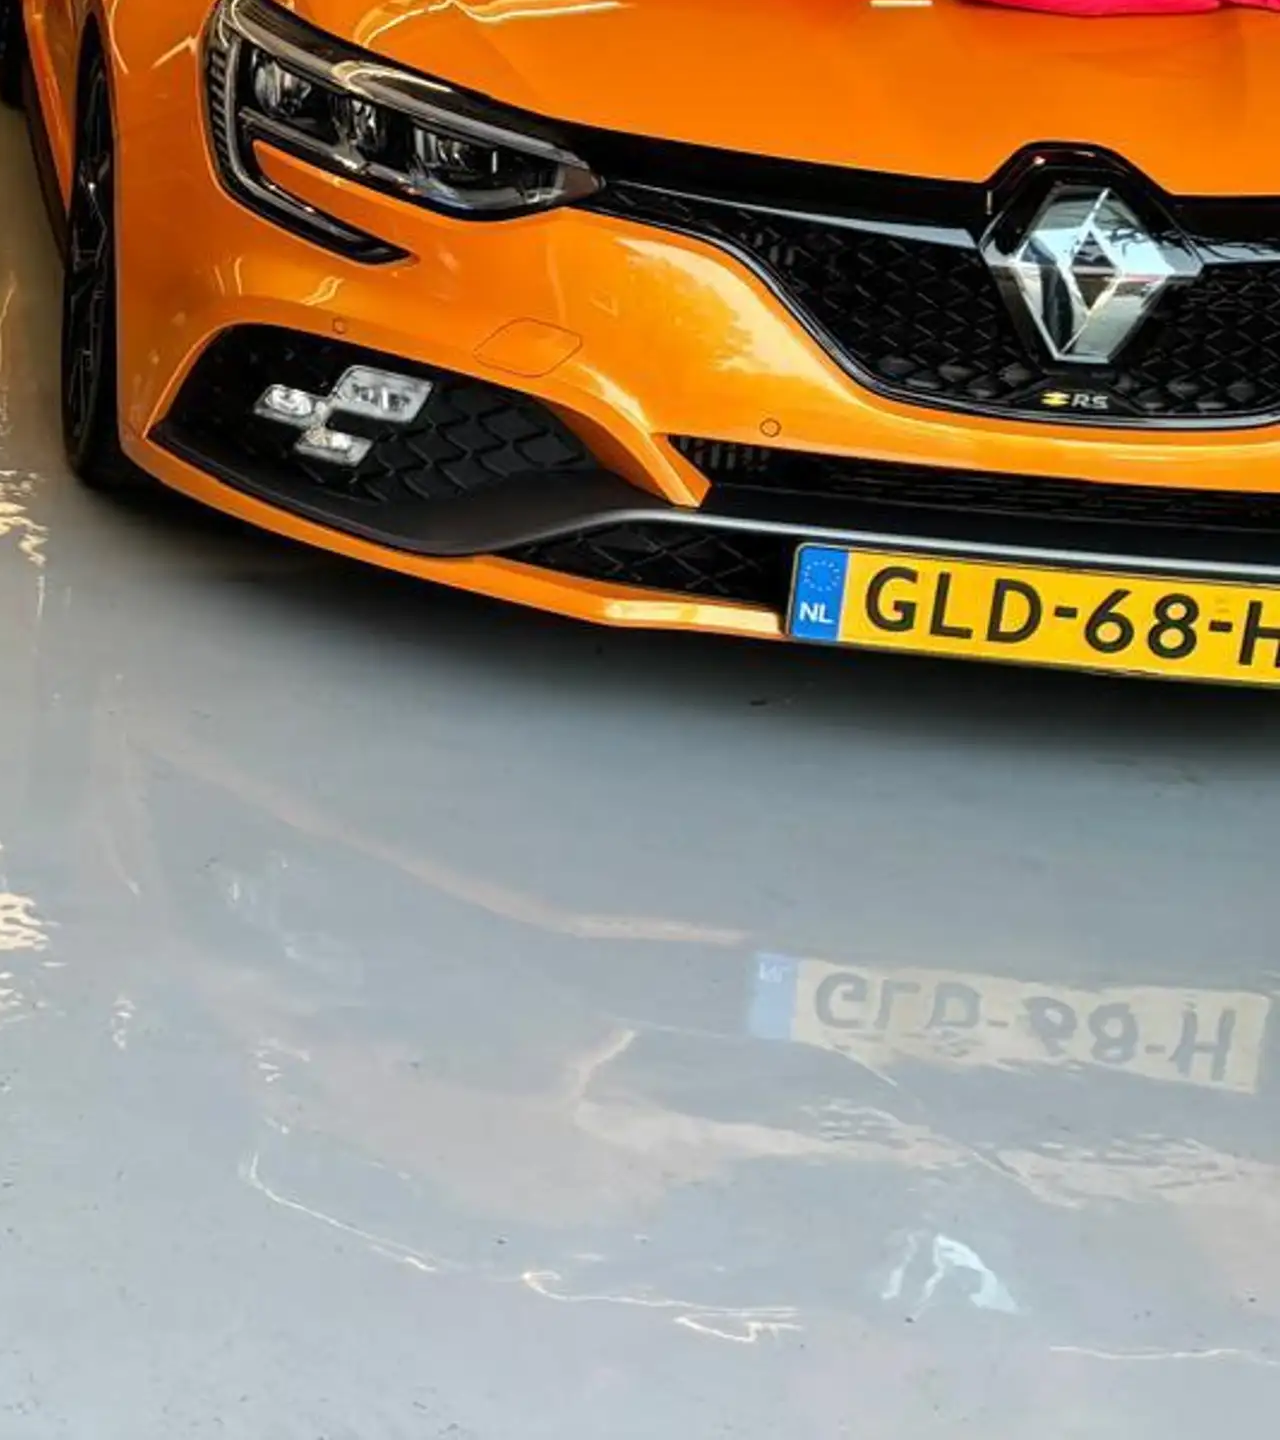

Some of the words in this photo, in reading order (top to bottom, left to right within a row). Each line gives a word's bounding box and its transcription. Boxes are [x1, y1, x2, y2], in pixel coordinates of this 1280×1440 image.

[1070, 393, 1109, 409] RS
[799, 601, 834, 623] NL
[865, 566, 1280, 668] GLD-68-H
